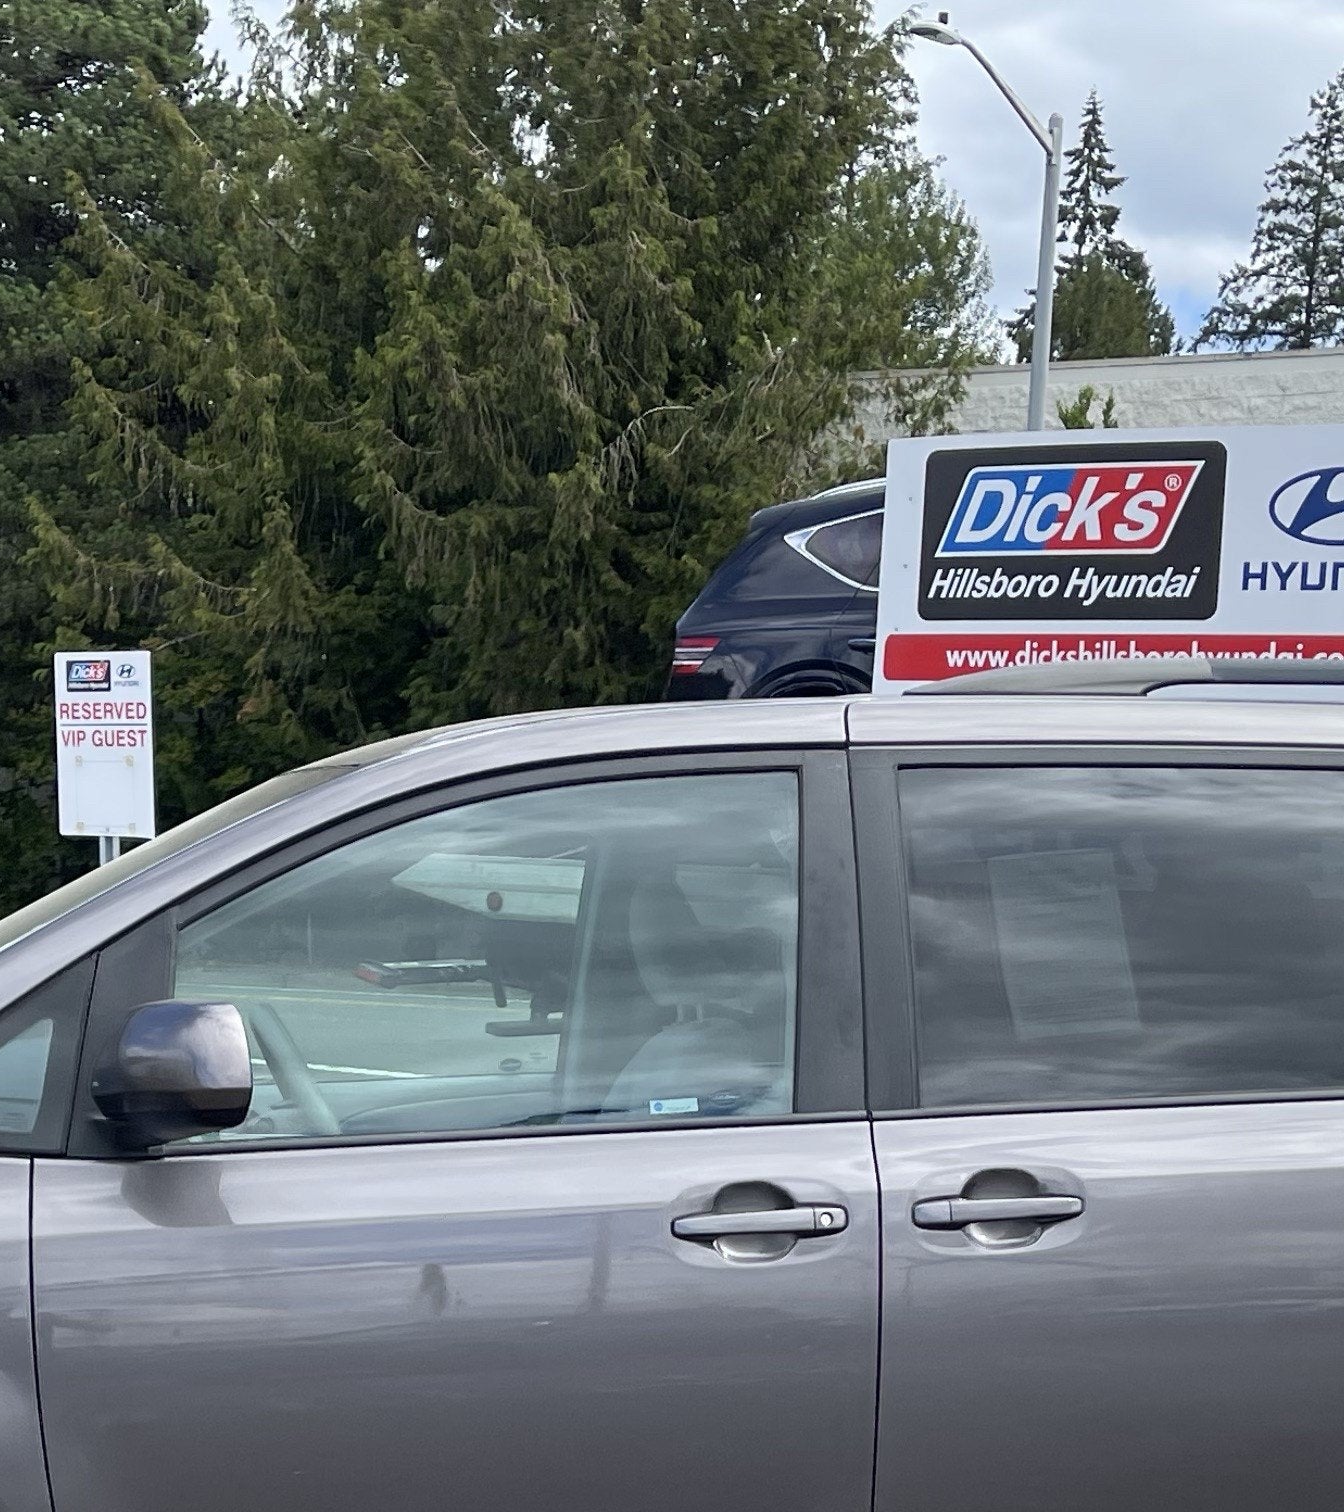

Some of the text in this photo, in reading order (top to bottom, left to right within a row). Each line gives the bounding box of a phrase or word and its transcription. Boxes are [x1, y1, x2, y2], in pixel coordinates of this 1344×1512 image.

[953, 473, 1167, 543] Dick's
[927, 565, 1202, 606] Hillsboro Hyundai
[59, 702, 147, 720] RESERVED
[61, 729, 147, 747] VIP GUEST
